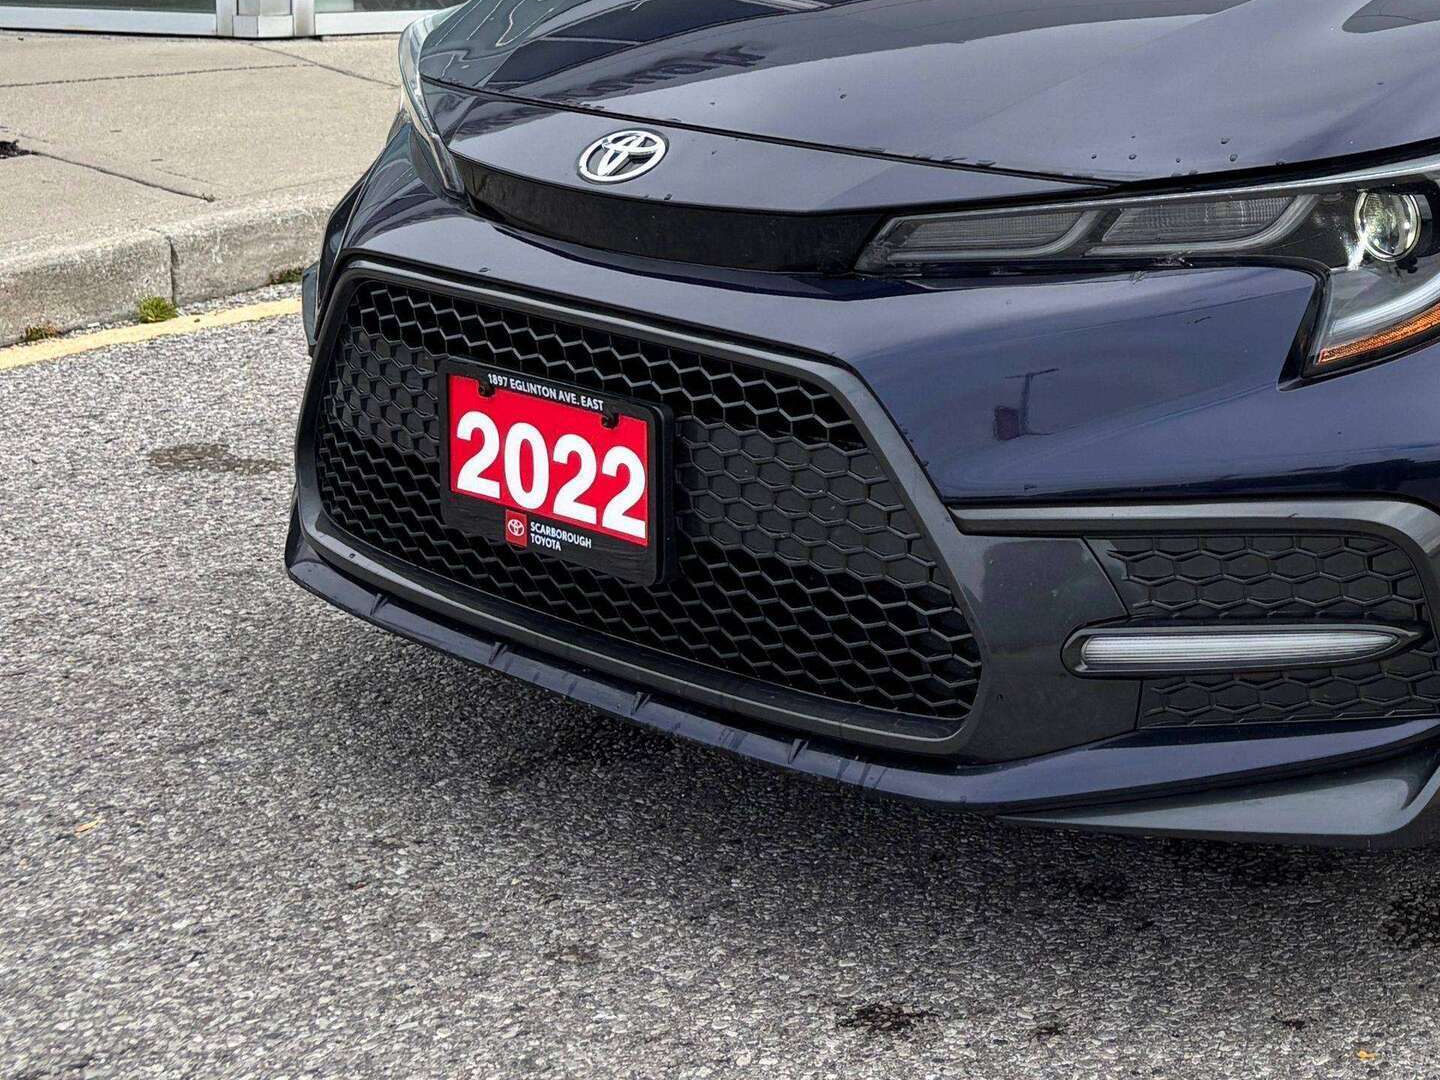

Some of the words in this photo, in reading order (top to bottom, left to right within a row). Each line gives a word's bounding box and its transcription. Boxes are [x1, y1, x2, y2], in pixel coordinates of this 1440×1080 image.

[487, 373, 508, 388] 1897
[509, 378, 557, 400] EGLINTON
[558, 390, 581, 406] AVE.
[581, 395, 605, 412] EAST
[456, 410, 646, 540] 2022
[530, 520, 592, 550] SCARBOROUGH
[530, 533, 562, 552] TOYOTA
